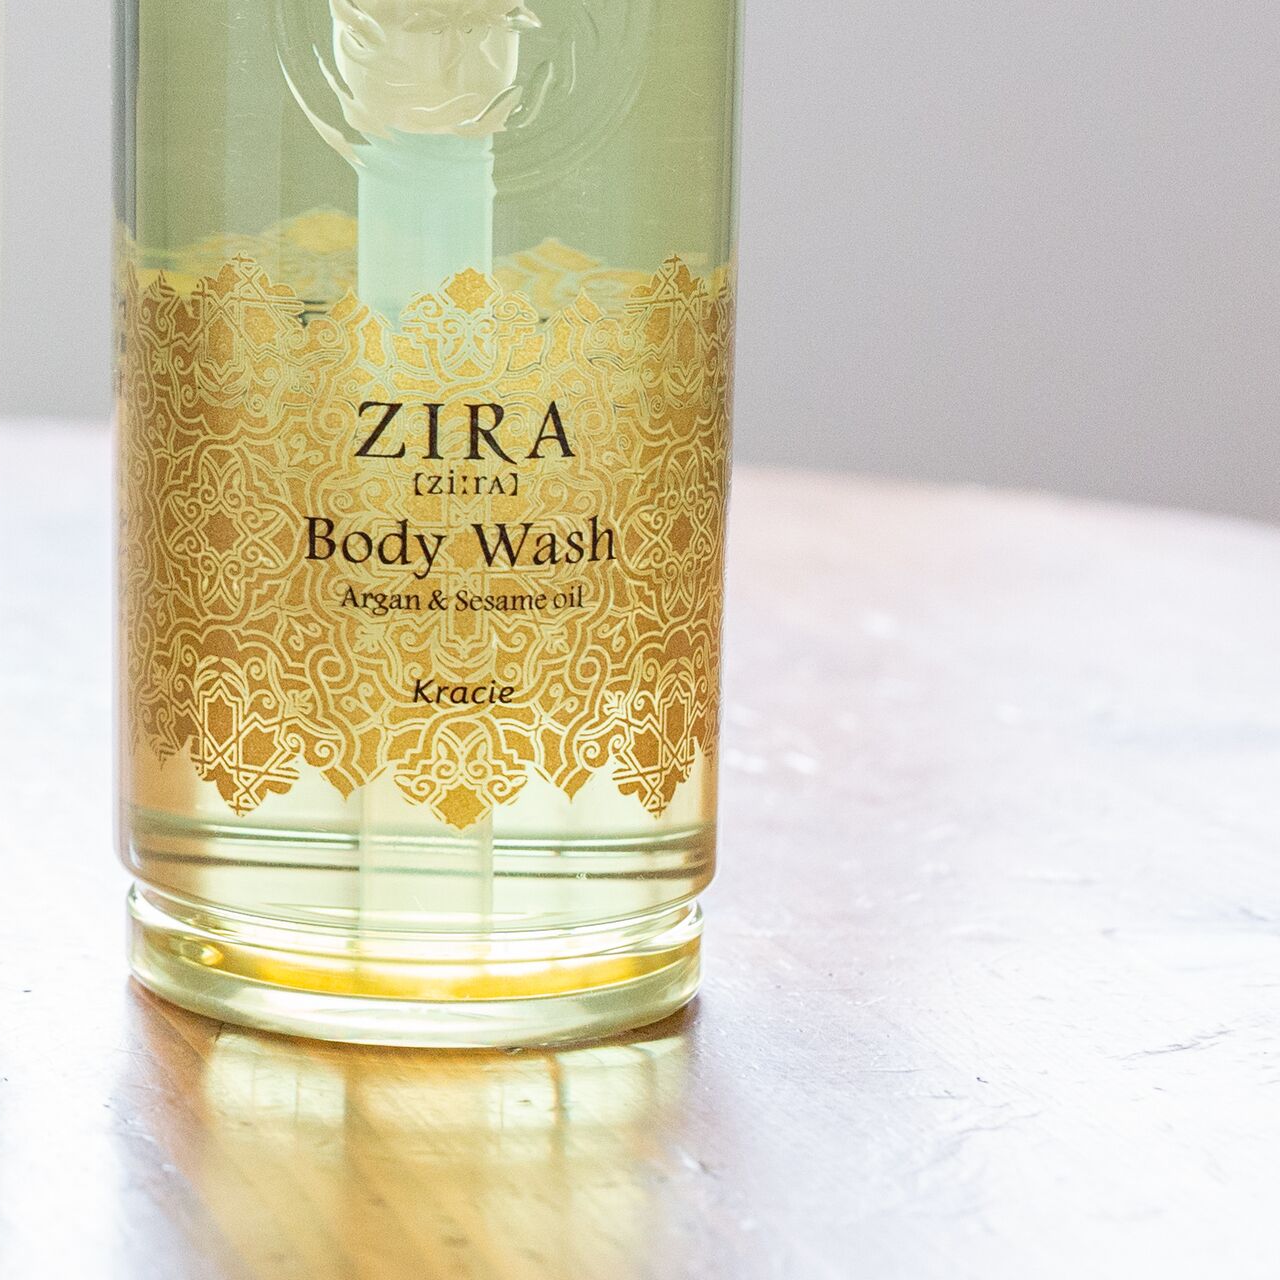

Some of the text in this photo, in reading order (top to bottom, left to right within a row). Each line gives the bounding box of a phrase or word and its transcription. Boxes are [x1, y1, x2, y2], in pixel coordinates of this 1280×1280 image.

[354, 400, 576, 465] ZIRA
[304, 514, 617, 580] Body Wash
[340, 585, 584, 616] Argan & Sesame oil
[412, 678, 515, 704] Kracie
